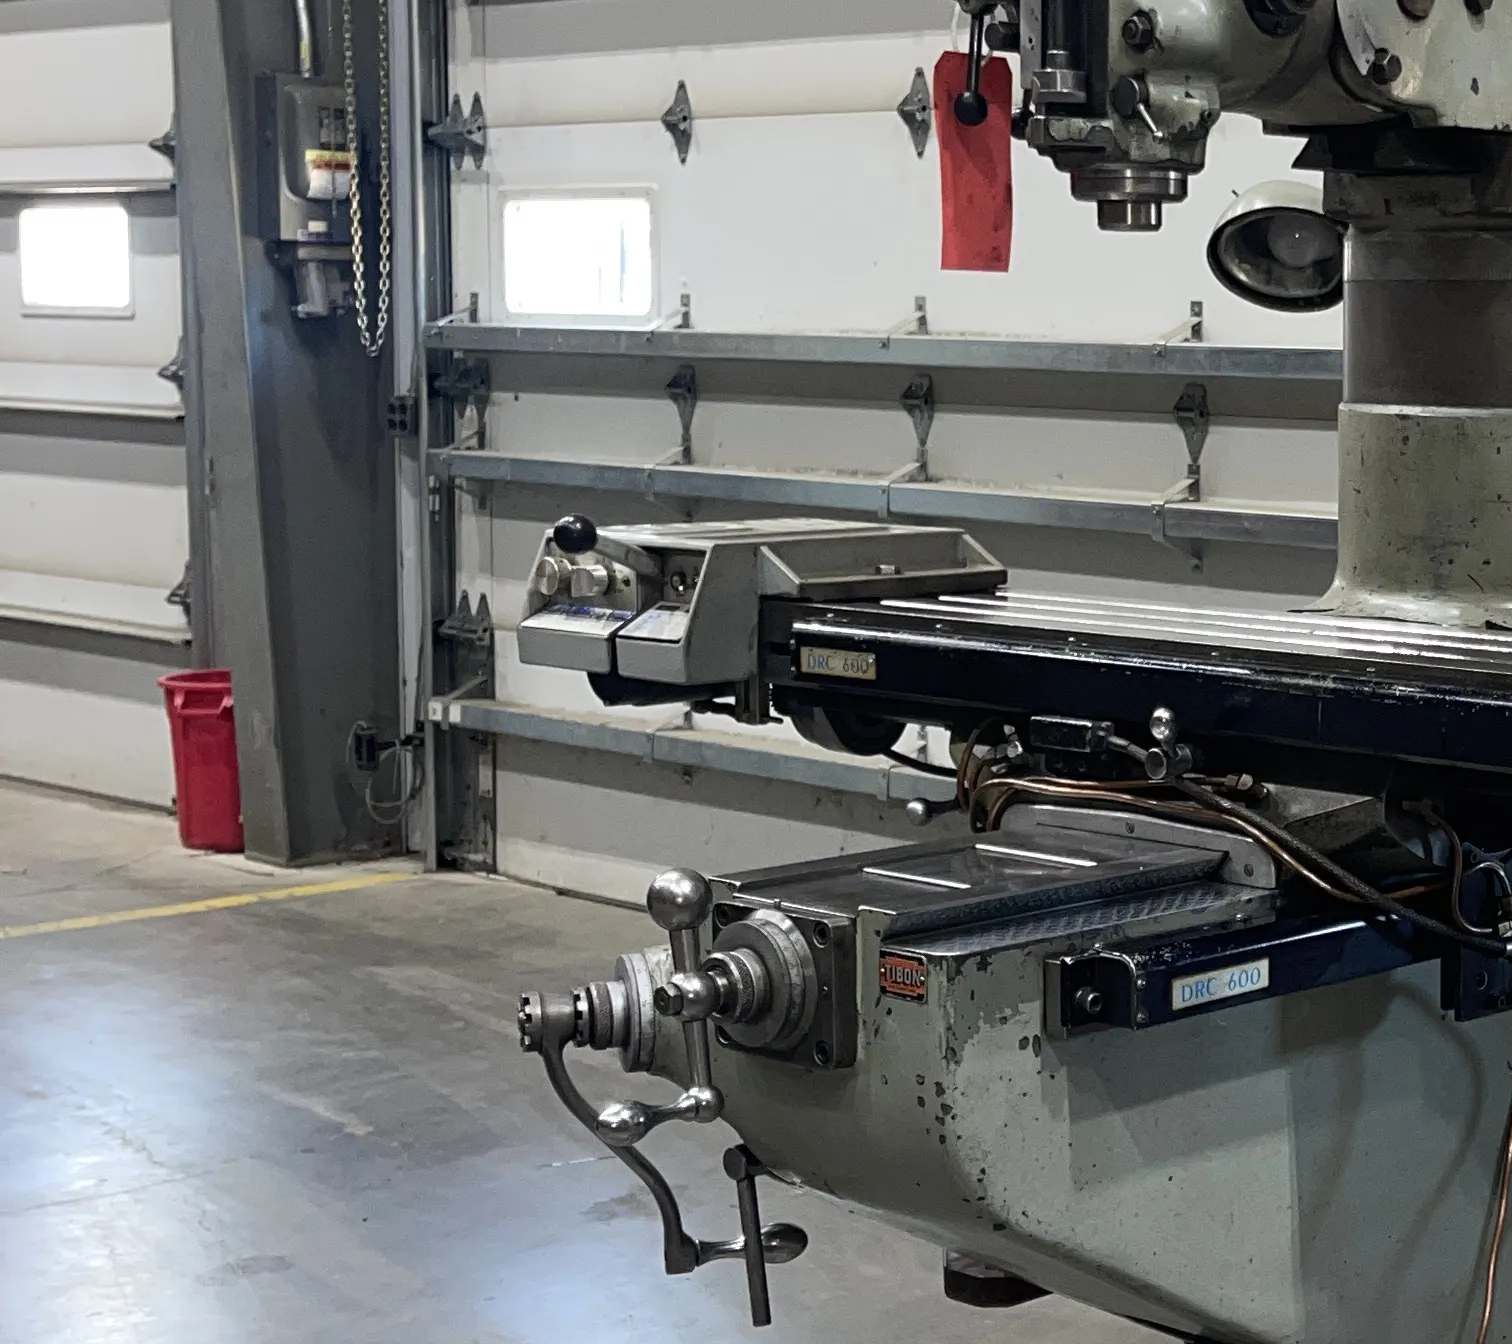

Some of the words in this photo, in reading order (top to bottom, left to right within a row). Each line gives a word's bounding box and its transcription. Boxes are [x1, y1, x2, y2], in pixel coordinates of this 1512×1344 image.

[808, 653, 837, 671] DRC
[843, 657, 869, 675] 600
[885, 964, 920, 987] TIBON
[1181, 977, 1217, 1002] DRC
[1228, 967, 1260, 992] 600
